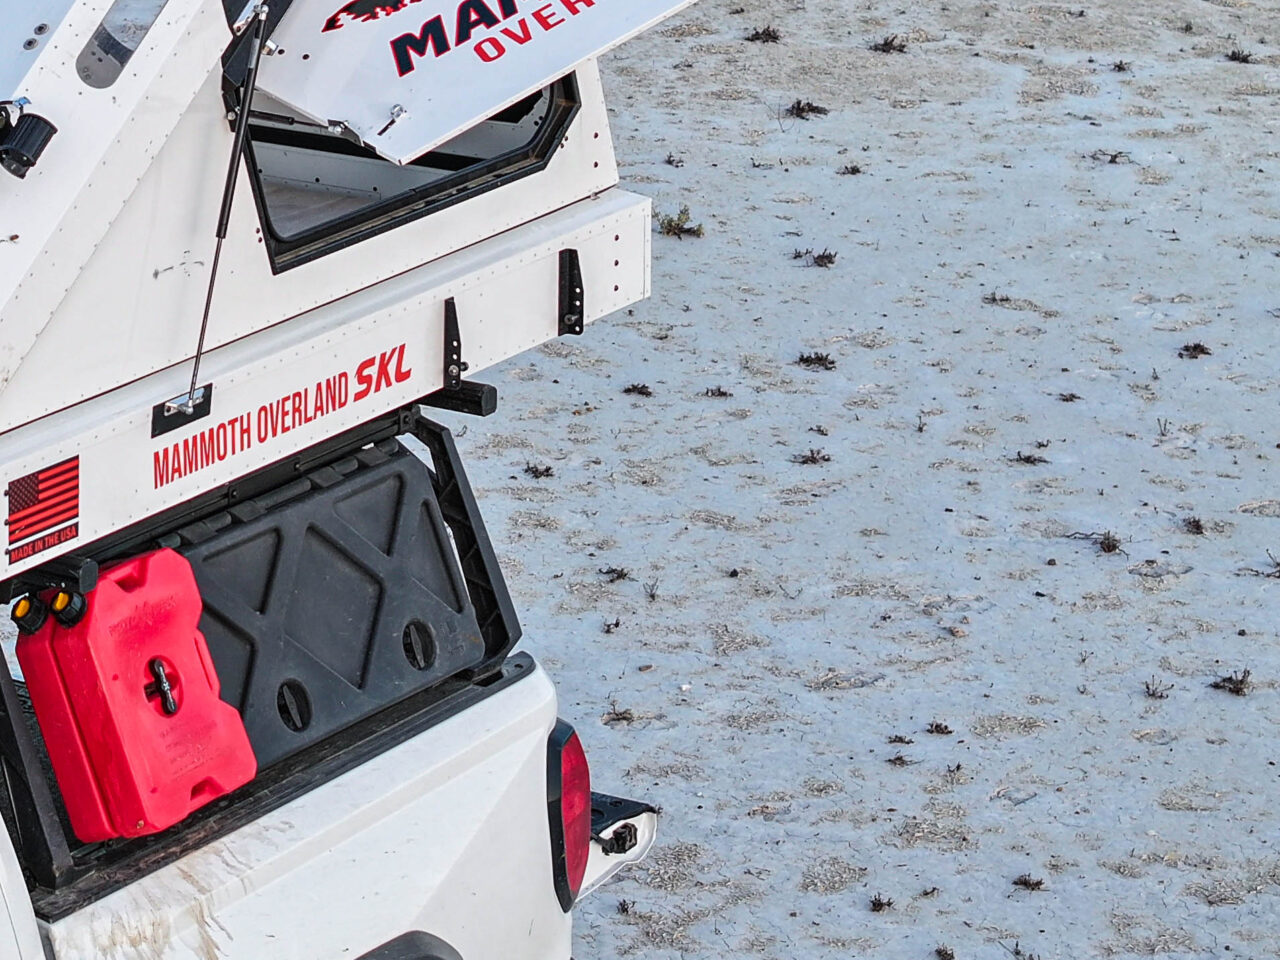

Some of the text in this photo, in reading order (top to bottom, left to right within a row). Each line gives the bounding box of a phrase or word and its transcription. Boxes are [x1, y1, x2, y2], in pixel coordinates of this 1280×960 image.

[153, 343, 412, 490] MAMMOTH OVERLAND SKL
[10, 525, 77, 563] MADE IN THE USA
